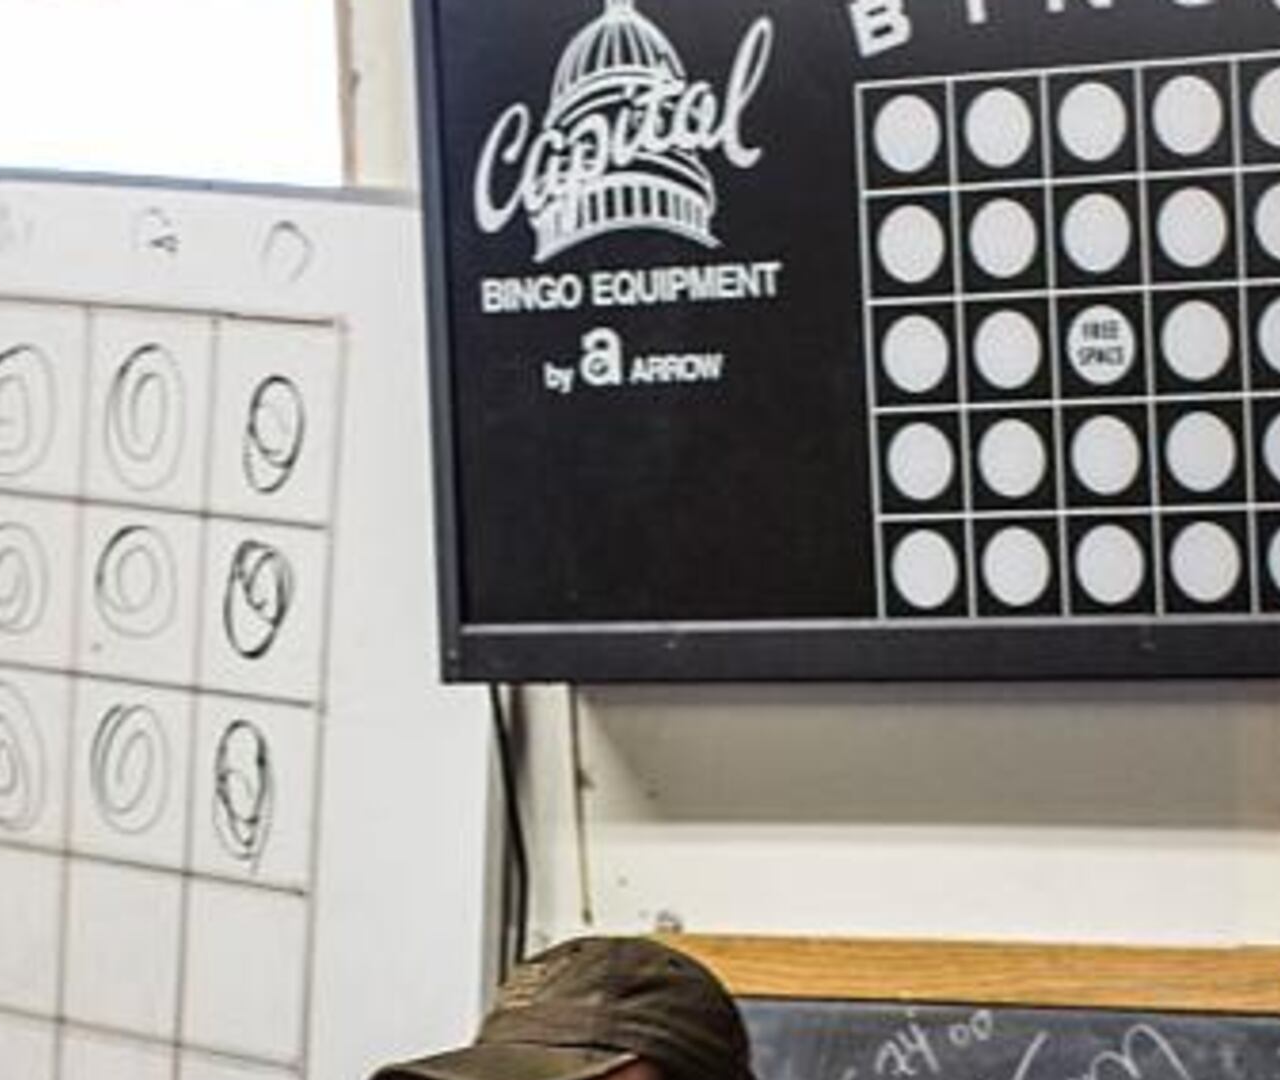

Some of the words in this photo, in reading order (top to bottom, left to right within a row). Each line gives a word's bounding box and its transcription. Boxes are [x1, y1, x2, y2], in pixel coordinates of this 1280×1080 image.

[481, 274, 582, 313] BINGO
[591, 261, 782, 306] EQUIPMENT
[1081, 320, 1119, 342] FREE
[543, 361, 575, 393] by
[629, 353, 724, 383] ARROW
